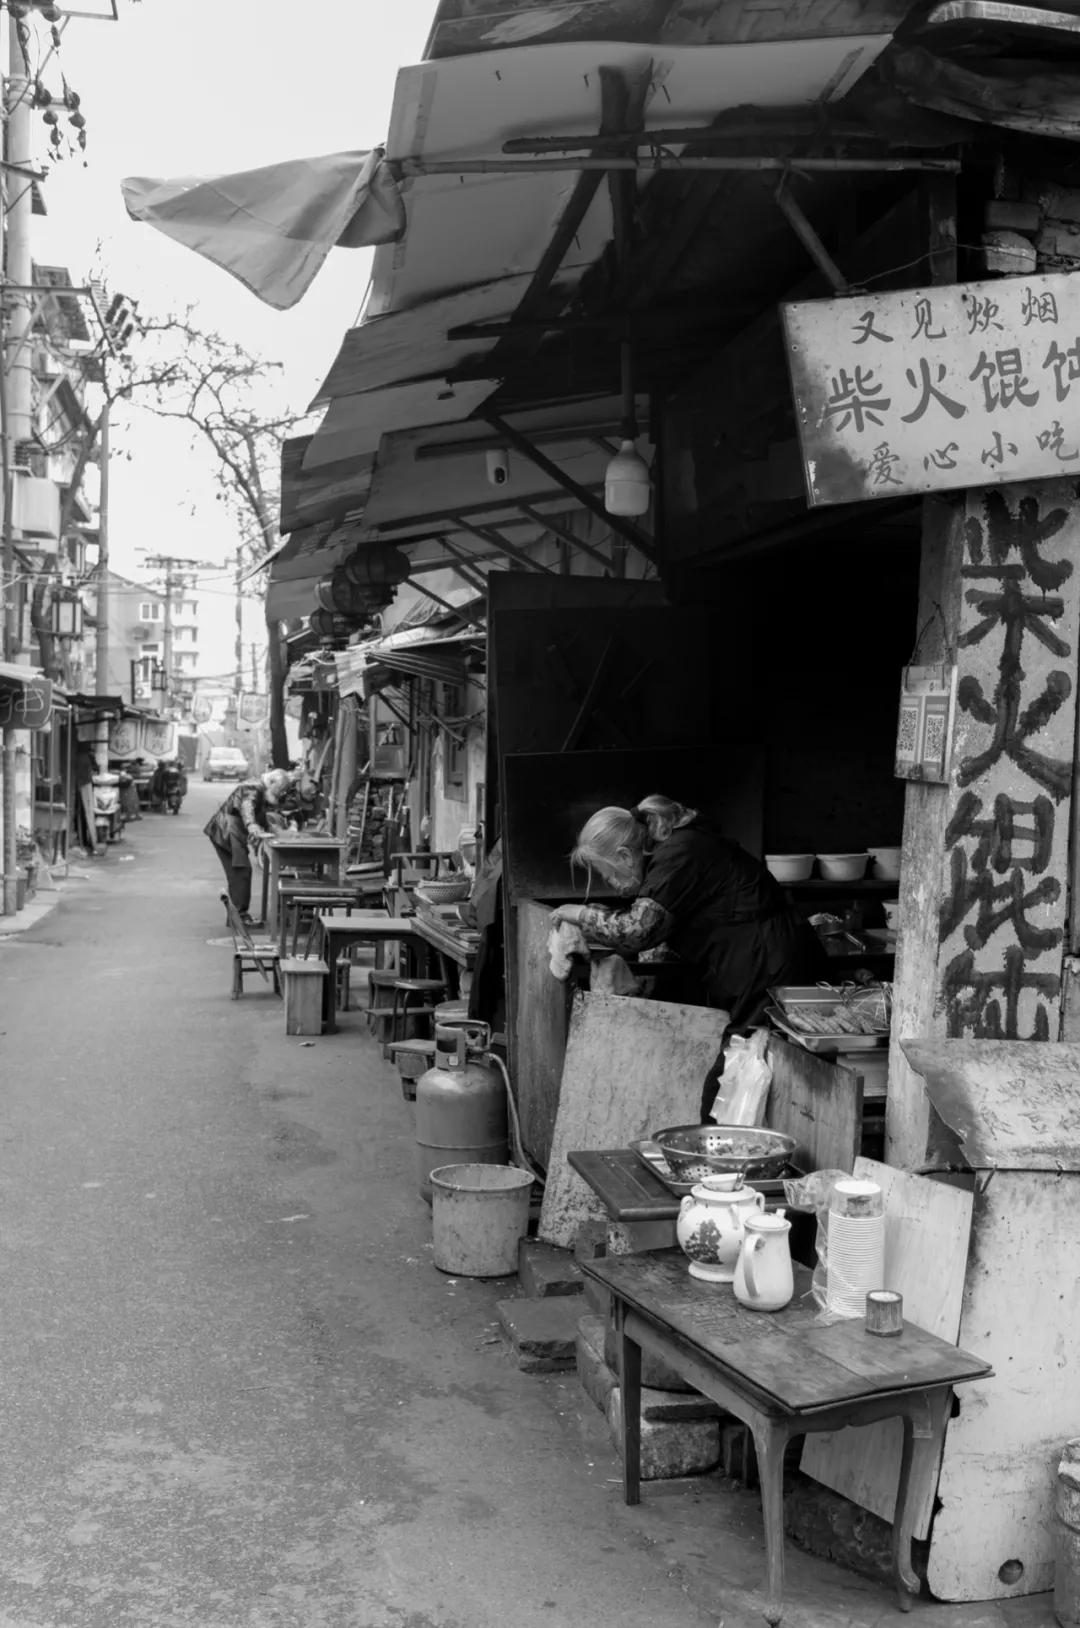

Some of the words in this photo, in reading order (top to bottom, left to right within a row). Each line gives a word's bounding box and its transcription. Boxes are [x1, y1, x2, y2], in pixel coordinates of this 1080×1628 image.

[851, 286, 1059, 345] 又见炊烟
[867, 420, 1079, 486] 爱心小吃
